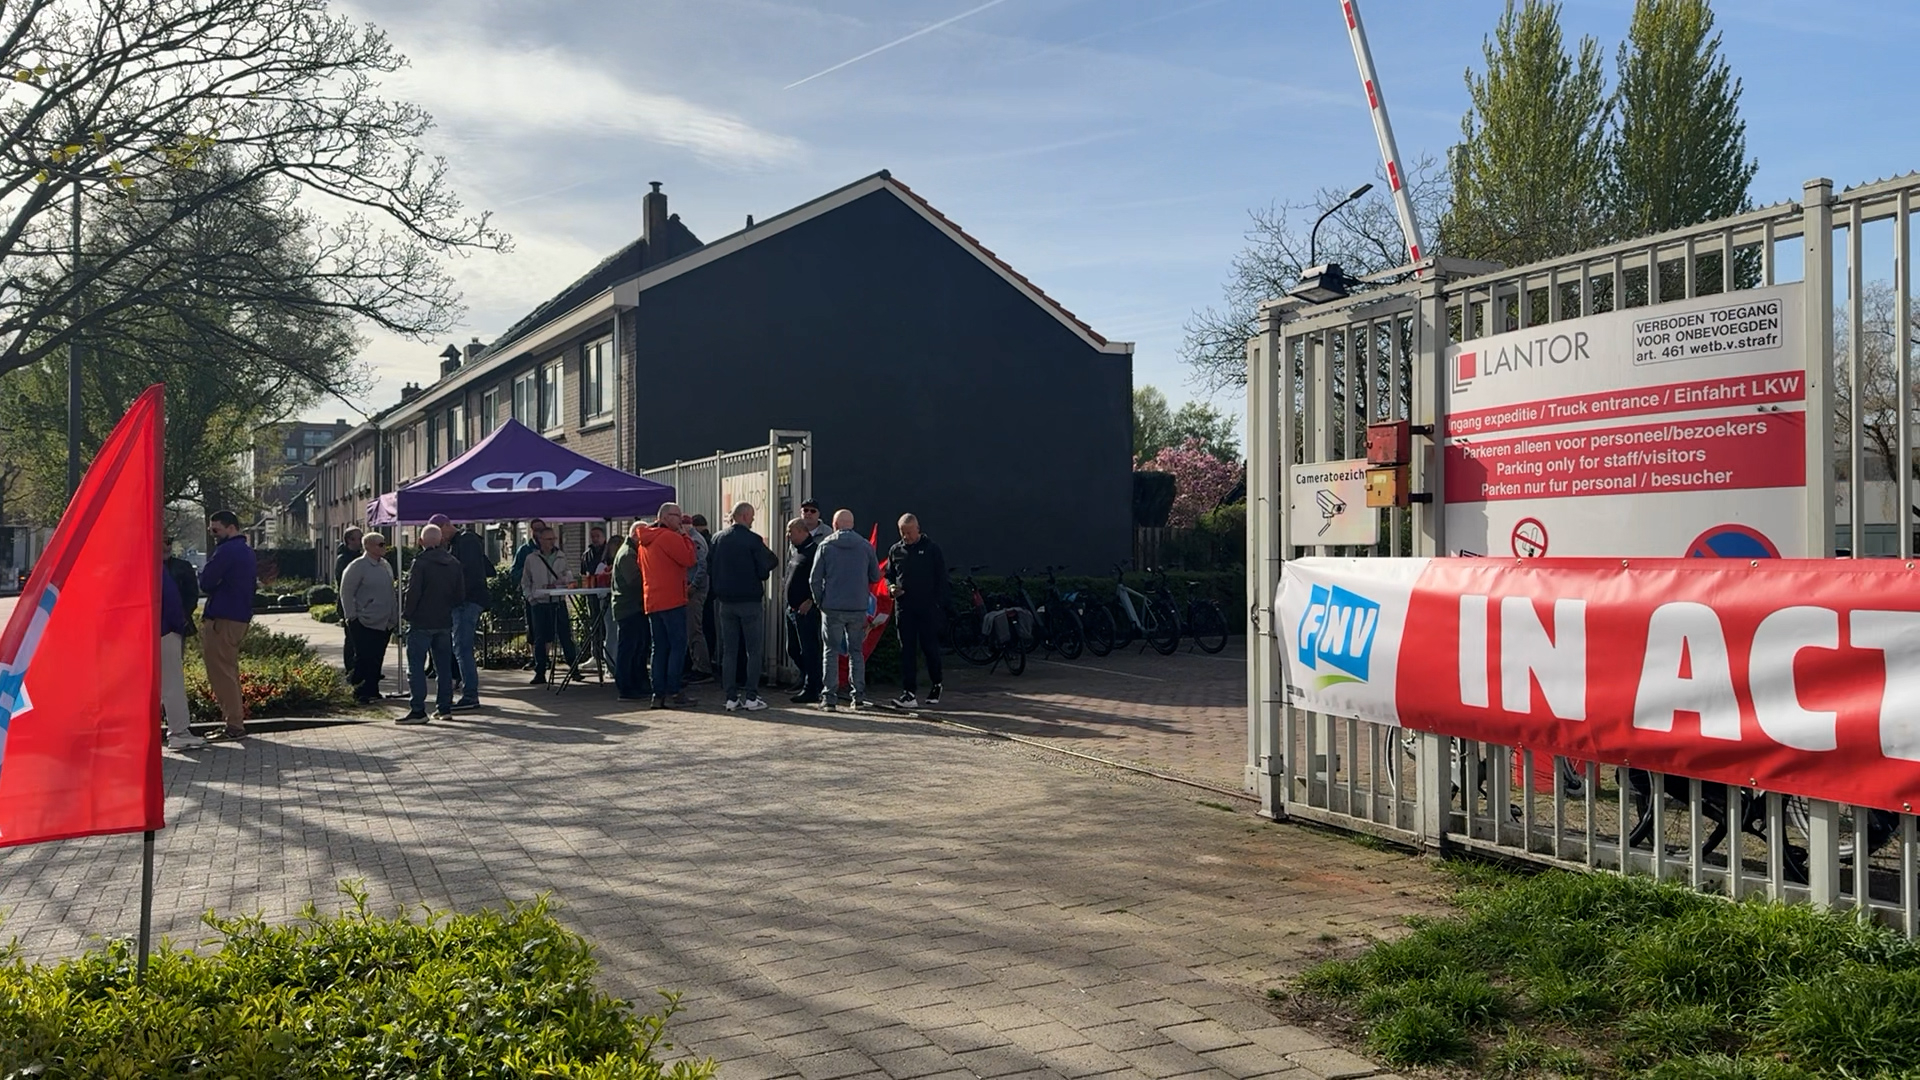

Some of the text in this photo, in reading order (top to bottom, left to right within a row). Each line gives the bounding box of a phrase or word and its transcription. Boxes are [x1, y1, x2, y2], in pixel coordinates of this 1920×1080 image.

[1636, 303, 1778, 334] VERBODEN TOEGANG
[1637, 318, 1778, 347] VOOR ONBEVOEGDEN
[1484, 331, 1590, 376] LANTOR
[1636, 333, 1778, 362] art. 461 wetb.v.strafr
[1484, 407, 1537, 427] expeditie
[1548, 400, 1588, 418] Truck
[1591, 393, 1659, 412] entrance
[1674, 383, 1746, 404] Einfahrt
[1752, 376, 1799, 396] LKW
[1463, 444, 1511, 459] Parkeren
[1514, 440, 1551, 455] alleen
[1555, 437, 1587, 450] voor
[1296, 469, 1368, 484] Cameratoezich
[1496, 460, 1543, 476] Parking
[1546, 456, 1575, 473] only
[1579, 455, 1600, 469] for
[1481, 483, 1521, 496] Parken
[1524, 481, 1546, 494] nur
[1572, 474, 1636, 494] personal
[1651, 470, 1733, 487] besucher
[1301, 603, 1377, 658] FNV
[1458, 594, 1587, 721] IN
